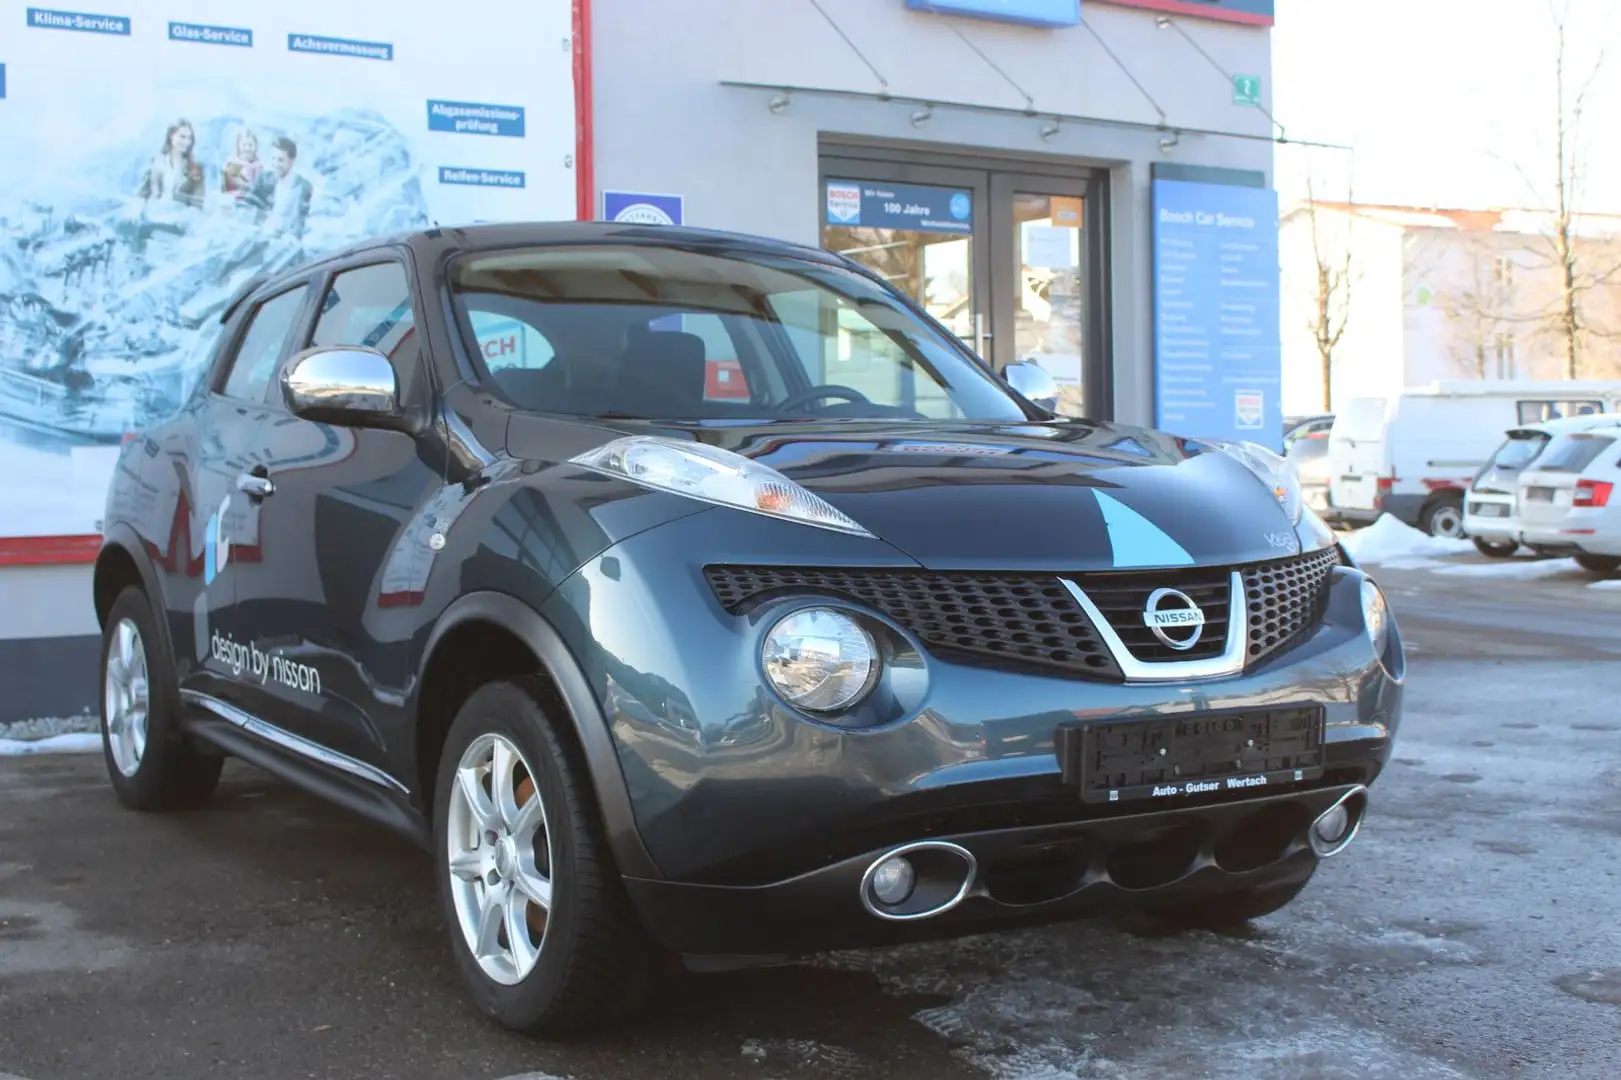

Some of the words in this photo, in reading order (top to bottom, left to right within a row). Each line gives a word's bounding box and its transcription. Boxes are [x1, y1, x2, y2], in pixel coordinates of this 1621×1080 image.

[34, 11, 124, 31] Klima-Service
[172, 25, 249, 44] Glas-Service
[443, 169, 521, 185] Reifen-Service
[829, 189, 859, 199] BOSCH
[884, 202, 901, 214] 100
[903, 203, 931, 216] Jahre
[481, 335, 516, 359] CH
[1155, 612, 1202, 624] NISSAN
[211, 628, 250, 676] design
[251, 640, 270, 686] by
[272, 649, 321, 694] nissan
[1152, 785, 1177, 797] Auto
[1186, 780, 1220, 793] Gutser
[1226, 774, 1268, 789] Wertach
